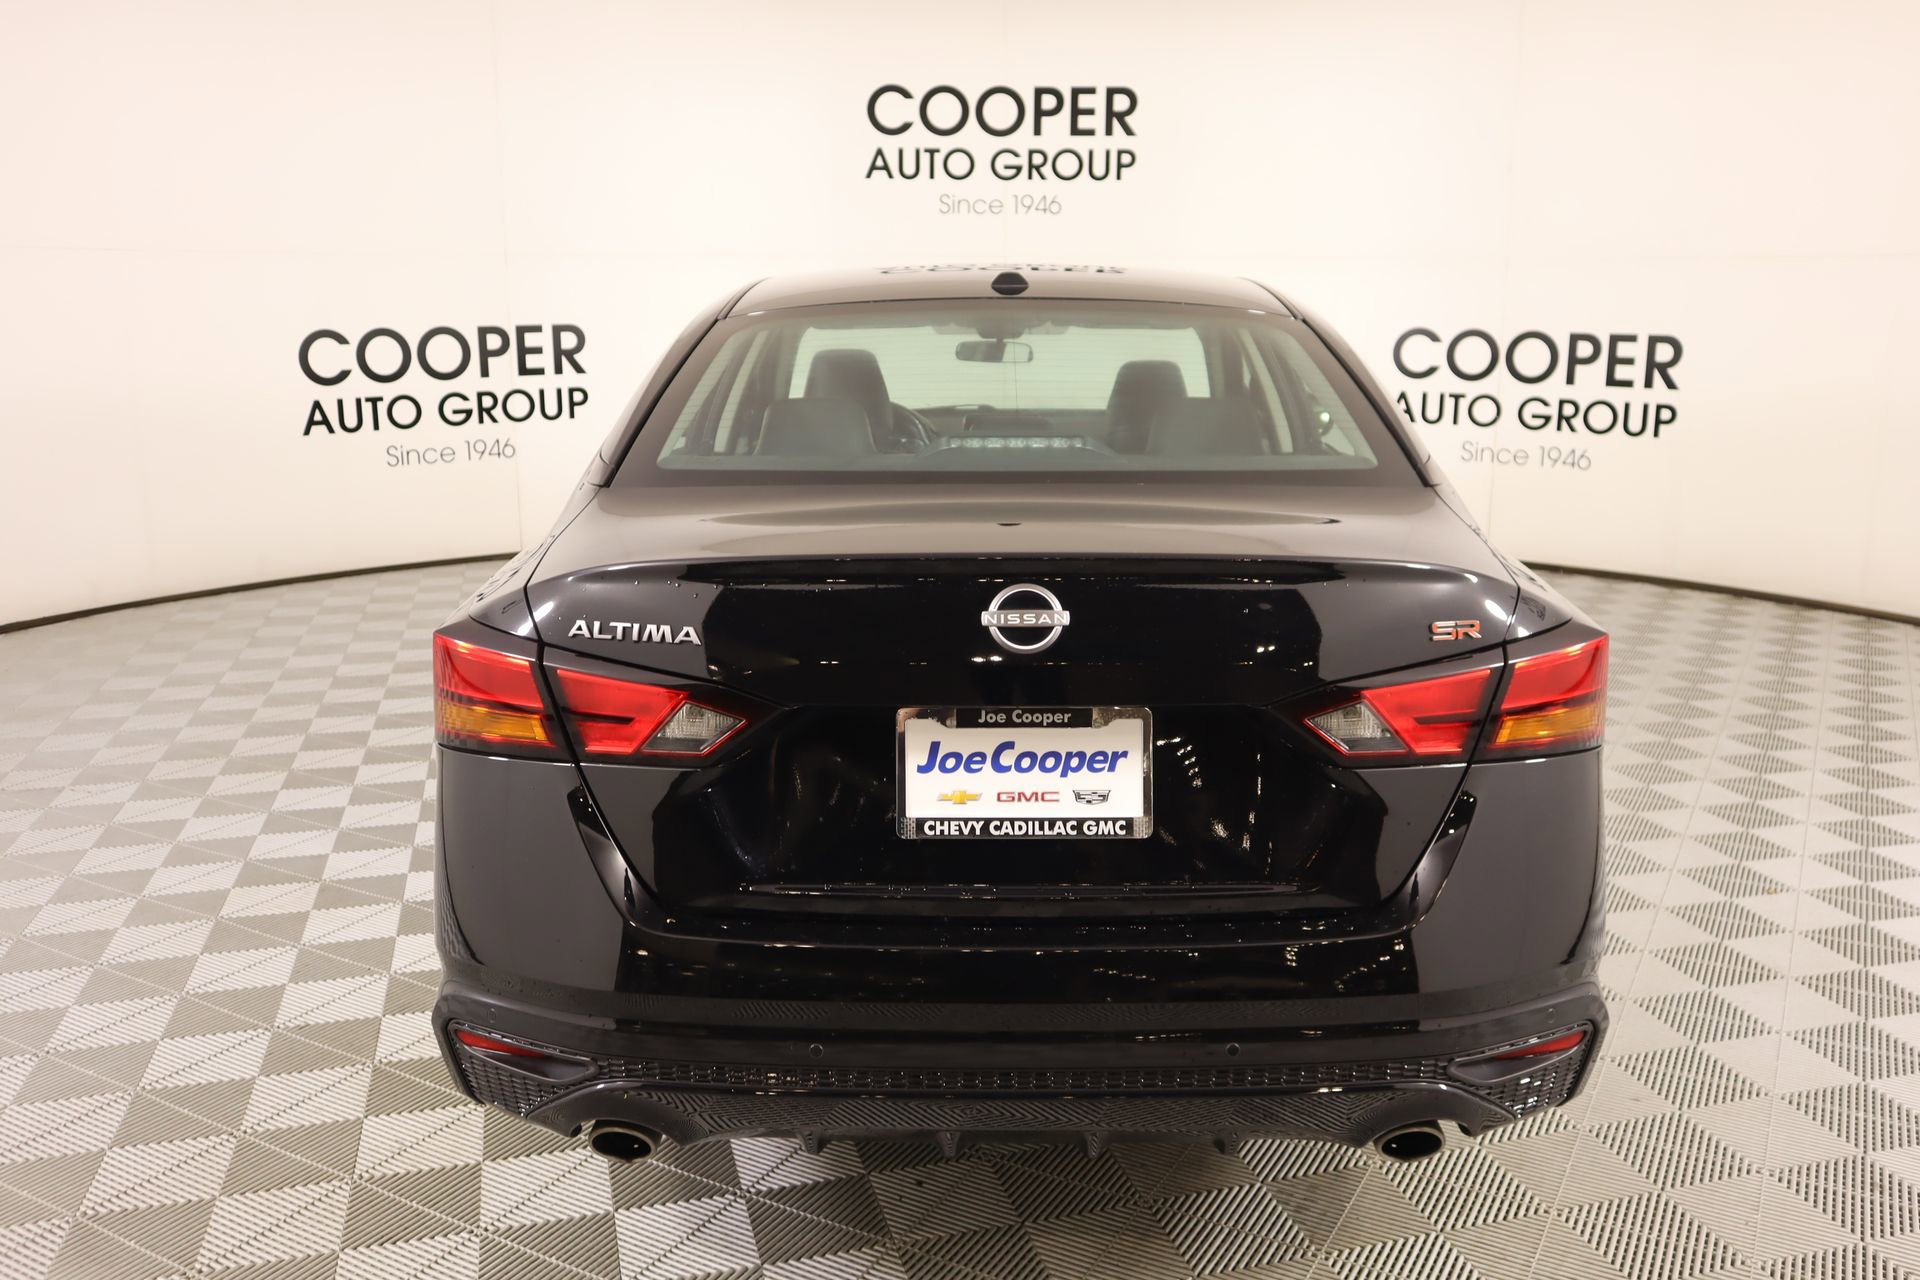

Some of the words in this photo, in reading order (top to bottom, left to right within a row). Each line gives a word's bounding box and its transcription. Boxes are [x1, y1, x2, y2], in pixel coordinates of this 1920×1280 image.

[867, 84, 1138, 136] COOPER
[865, 147, 975, 180] AUTO
[990, 148, 1136, 181] GROUP
[938, 193, 1004, 214] Since
[1013, 194, 1062, 215] 1946
[298, 324, 587, 386] COOPER
[1393, 327, 1683, 390] COOPER
[303, 394, 422, 436] AUTO
[438, 387, 589, 426] GROUP
[1396, 391, 1502, 427] AUTO
[1517, 397, 1678, 438] GROUP
[386, 444, 456, 467] Since
[464, 438, 516, 461] 1946
[1460, 440, 1529, 466] Since
[1538, 446, 1592, 471] 1946
[567, 619, 702, 646] ALTIMA
[984, 613, 1067, 625] NISSAN
[1430, 619, 1482, 641] SR
[977, 710, 1006, 723] Joe
[1012, 710, 1072, 726] Cooper
[996, 791, 1060, 803] GMC
[923, 820, 985, 836] CHEVY
[989, 820, 1078, 836] CADILLAC
[1082, 820, 1127, 836] GMC
